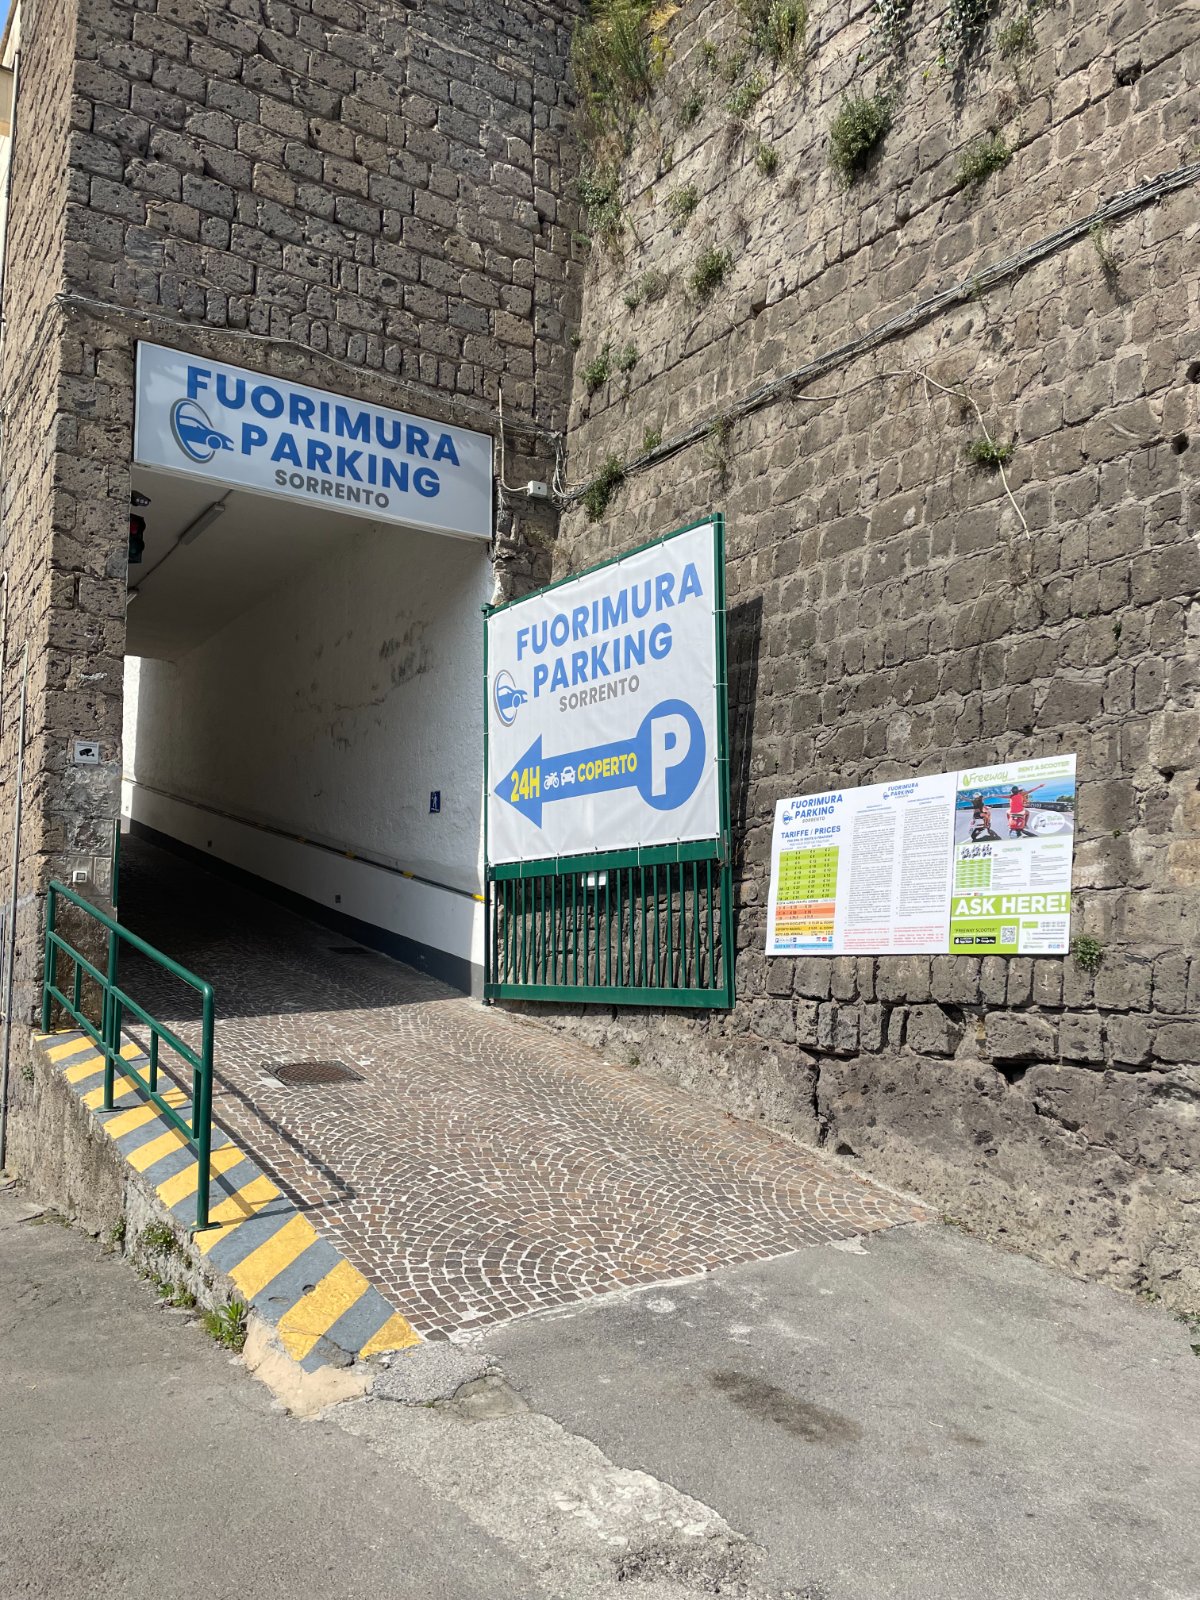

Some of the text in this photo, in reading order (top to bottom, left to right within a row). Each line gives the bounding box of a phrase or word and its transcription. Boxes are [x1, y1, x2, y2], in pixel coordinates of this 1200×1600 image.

[186, 365, 459, 465] FUORIMURA
[241, 422, 440, 498] PARKING
[274, 469, 390, 509] SORRENTO
[517, 562, 704, 662] FUORIMURA
[533, 622, 673, 699] PARKING
[559, 674, 641, 713] SORRENTO
[651, 713, 692, 797] P
[510, 752, 638, 803] 24H COPERTO
[890, 789, 914, 797] PARKING
[969, 771, 1008, 783] Freeway
[790, 794, 843, 810] FUORIMURA
[794, 806, 835, 819] PARKING
[781, 829, 809, 839] TARIFFE
[814, 825, 841, 836] PRICES
[954, 894, 1067, 916] ASK HERE!
